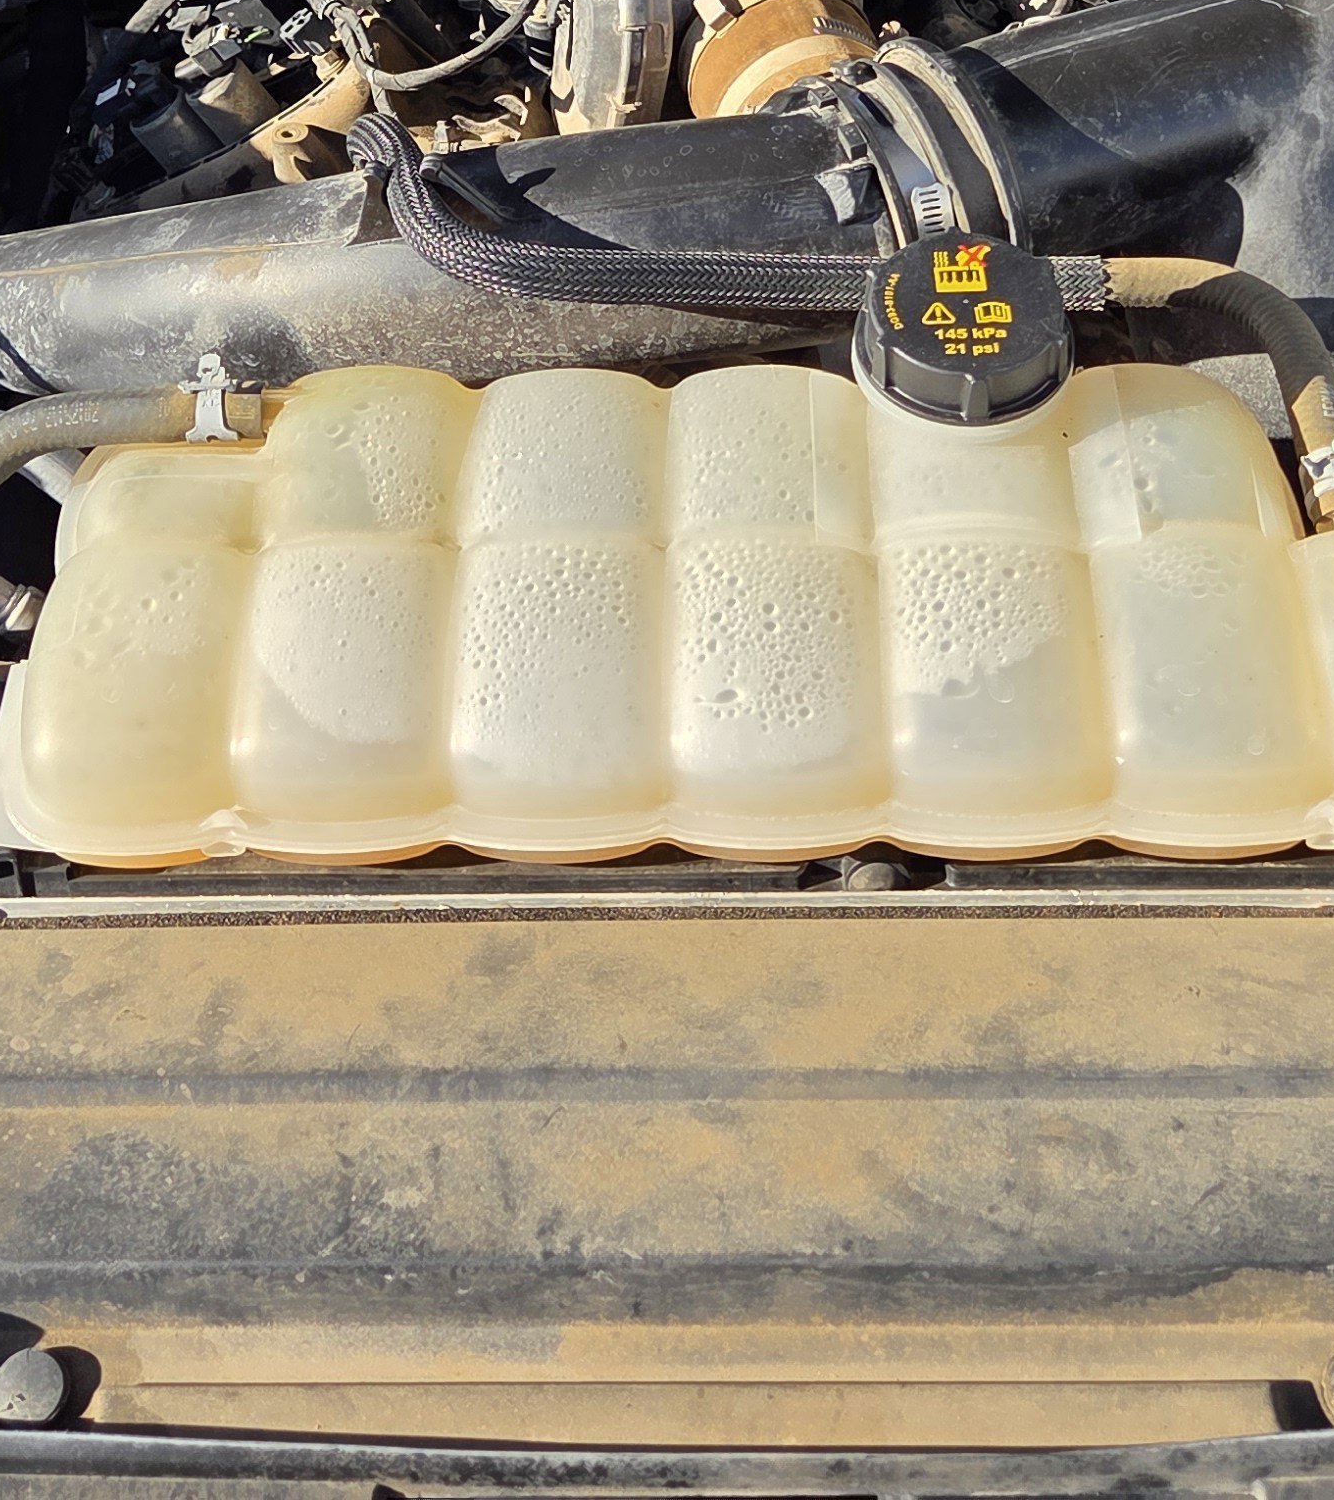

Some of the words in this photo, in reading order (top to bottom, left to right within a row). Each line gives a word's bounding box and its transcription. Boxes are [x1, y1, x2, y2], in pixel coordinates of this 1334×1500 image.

[934, 328, 968, 339] 145
[972, 327, 1008, 339] kPa
[944, 343, 966, 355] 21
[972, 342, 1000, 356] psi
